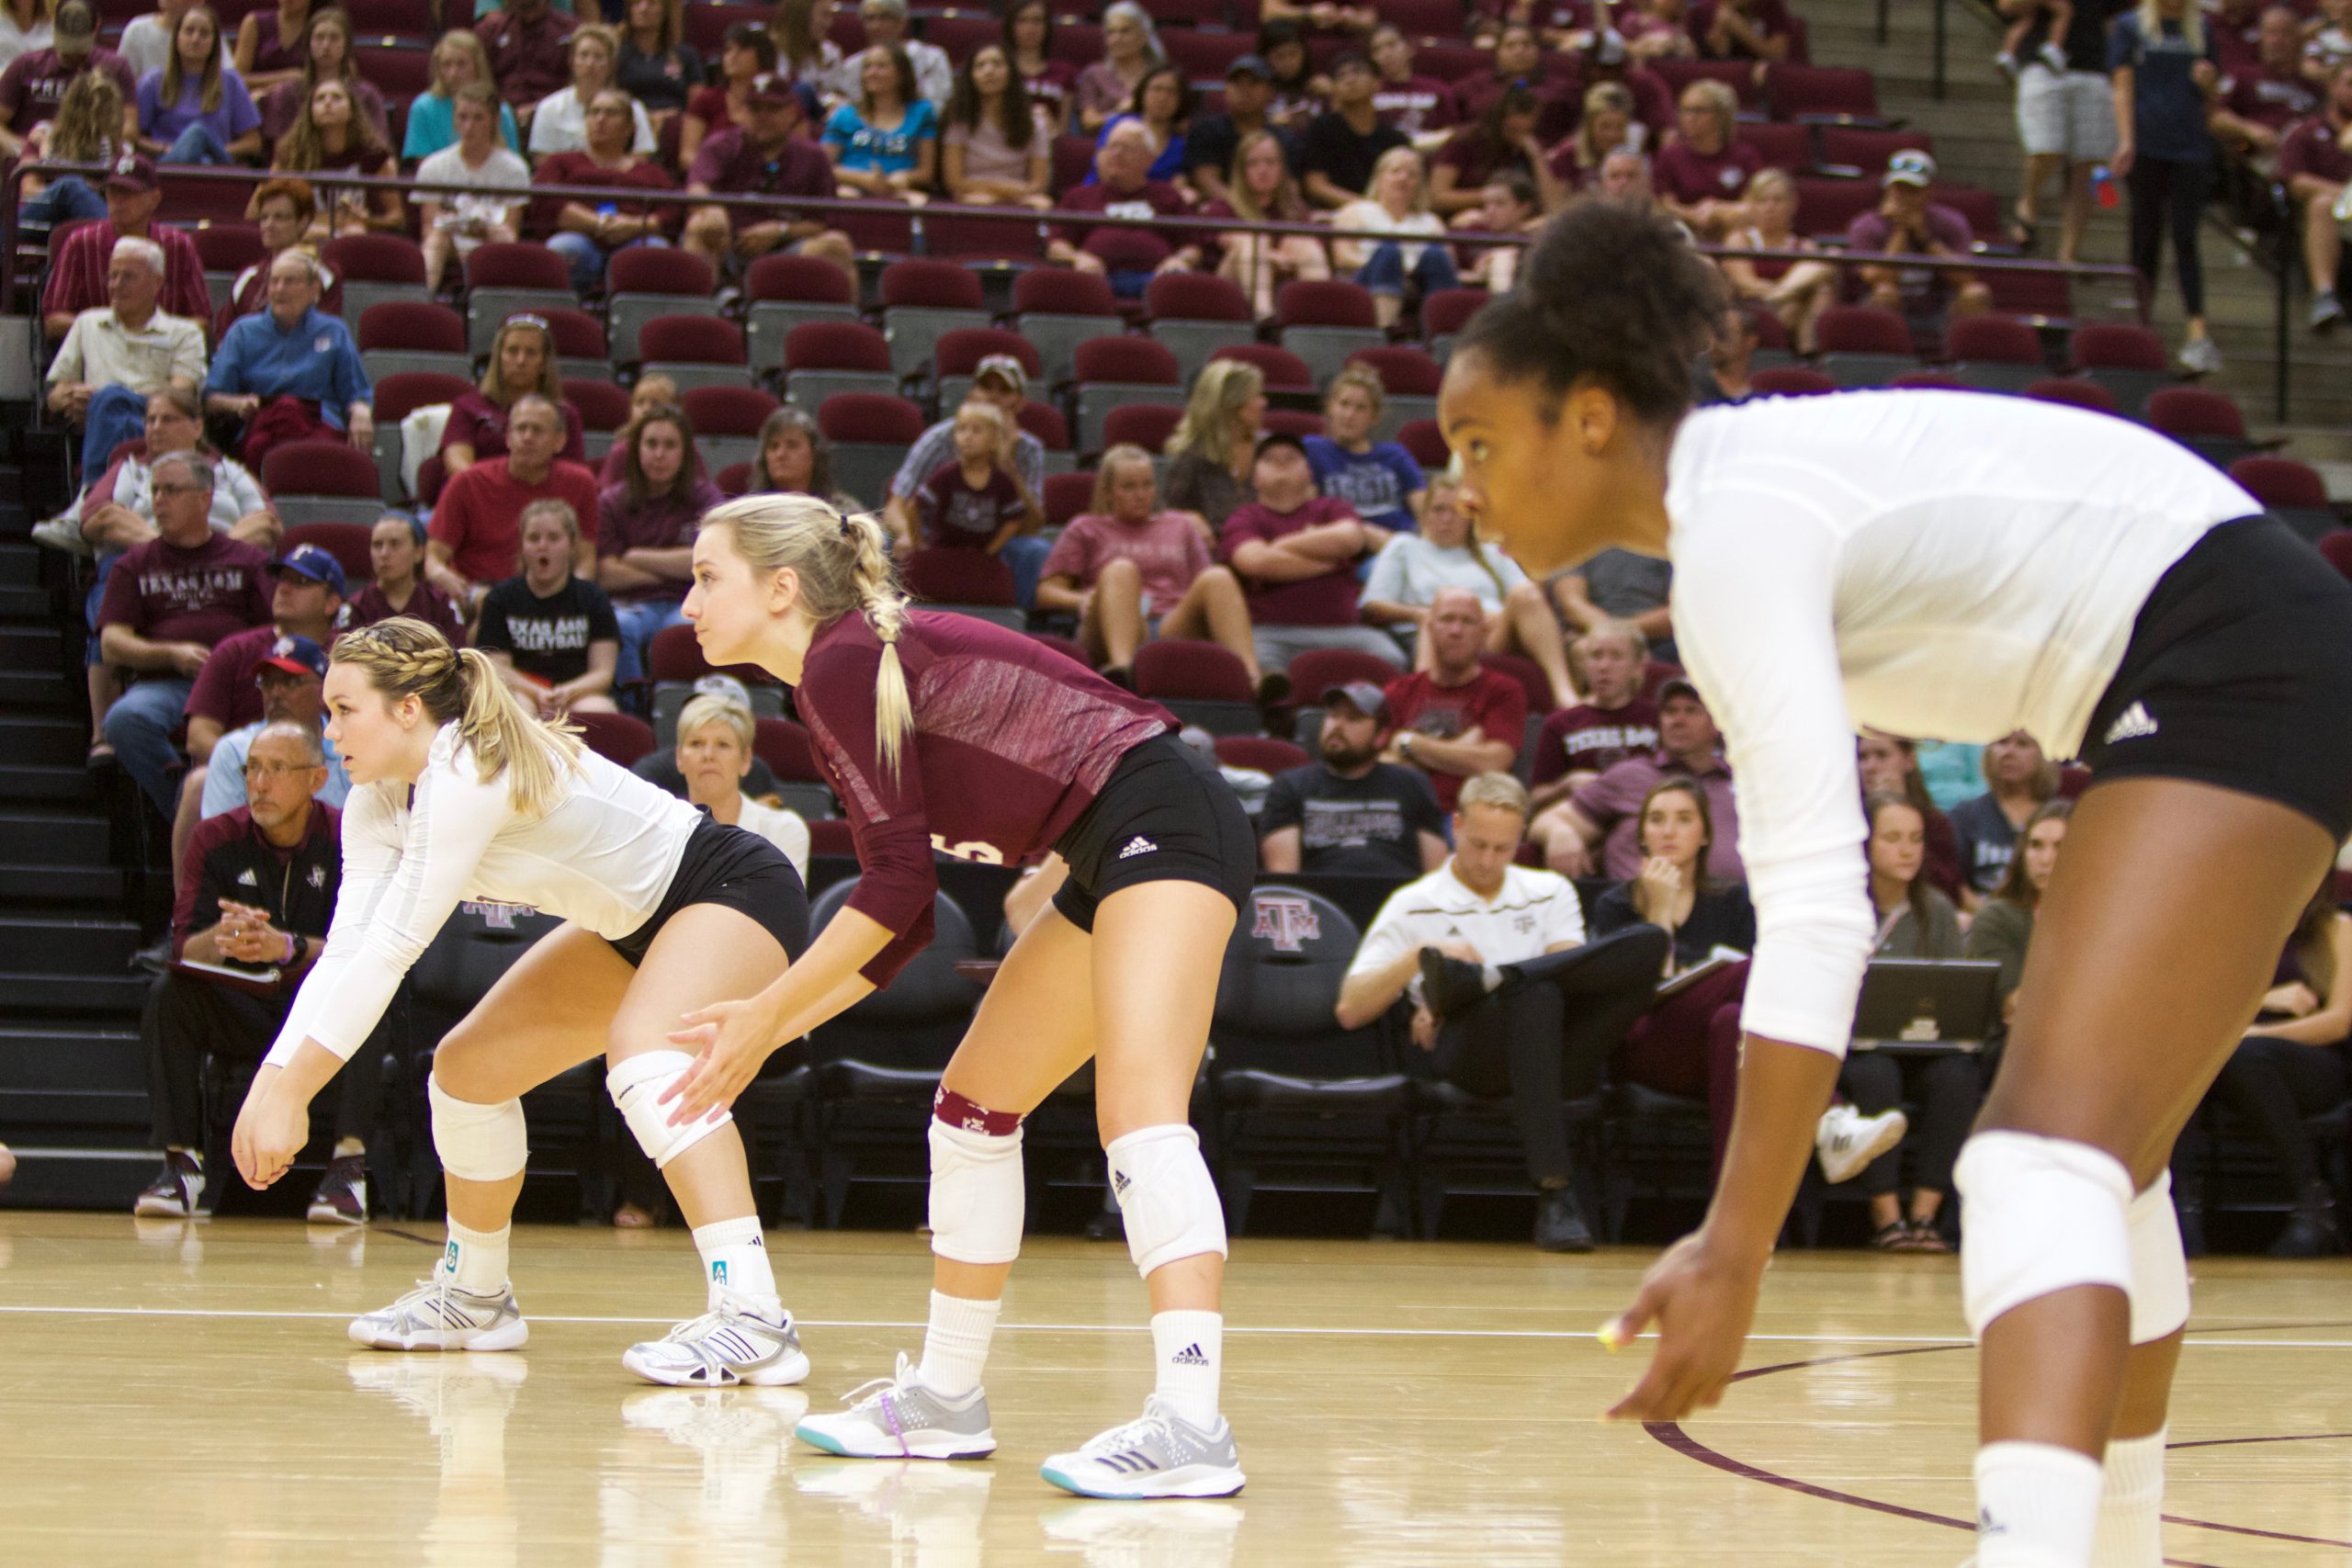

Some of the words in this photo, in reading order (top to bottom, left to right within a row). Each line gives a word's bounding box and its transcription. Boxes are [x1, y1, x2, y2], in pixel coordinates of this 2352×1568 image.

[139, 572, 198, 598] TEXAS
[1565, 726, 1621, 755] TEXAS
[1119, 843, 1158, 860] adidas
[1171, 1355, 1209, 1366] adidas
